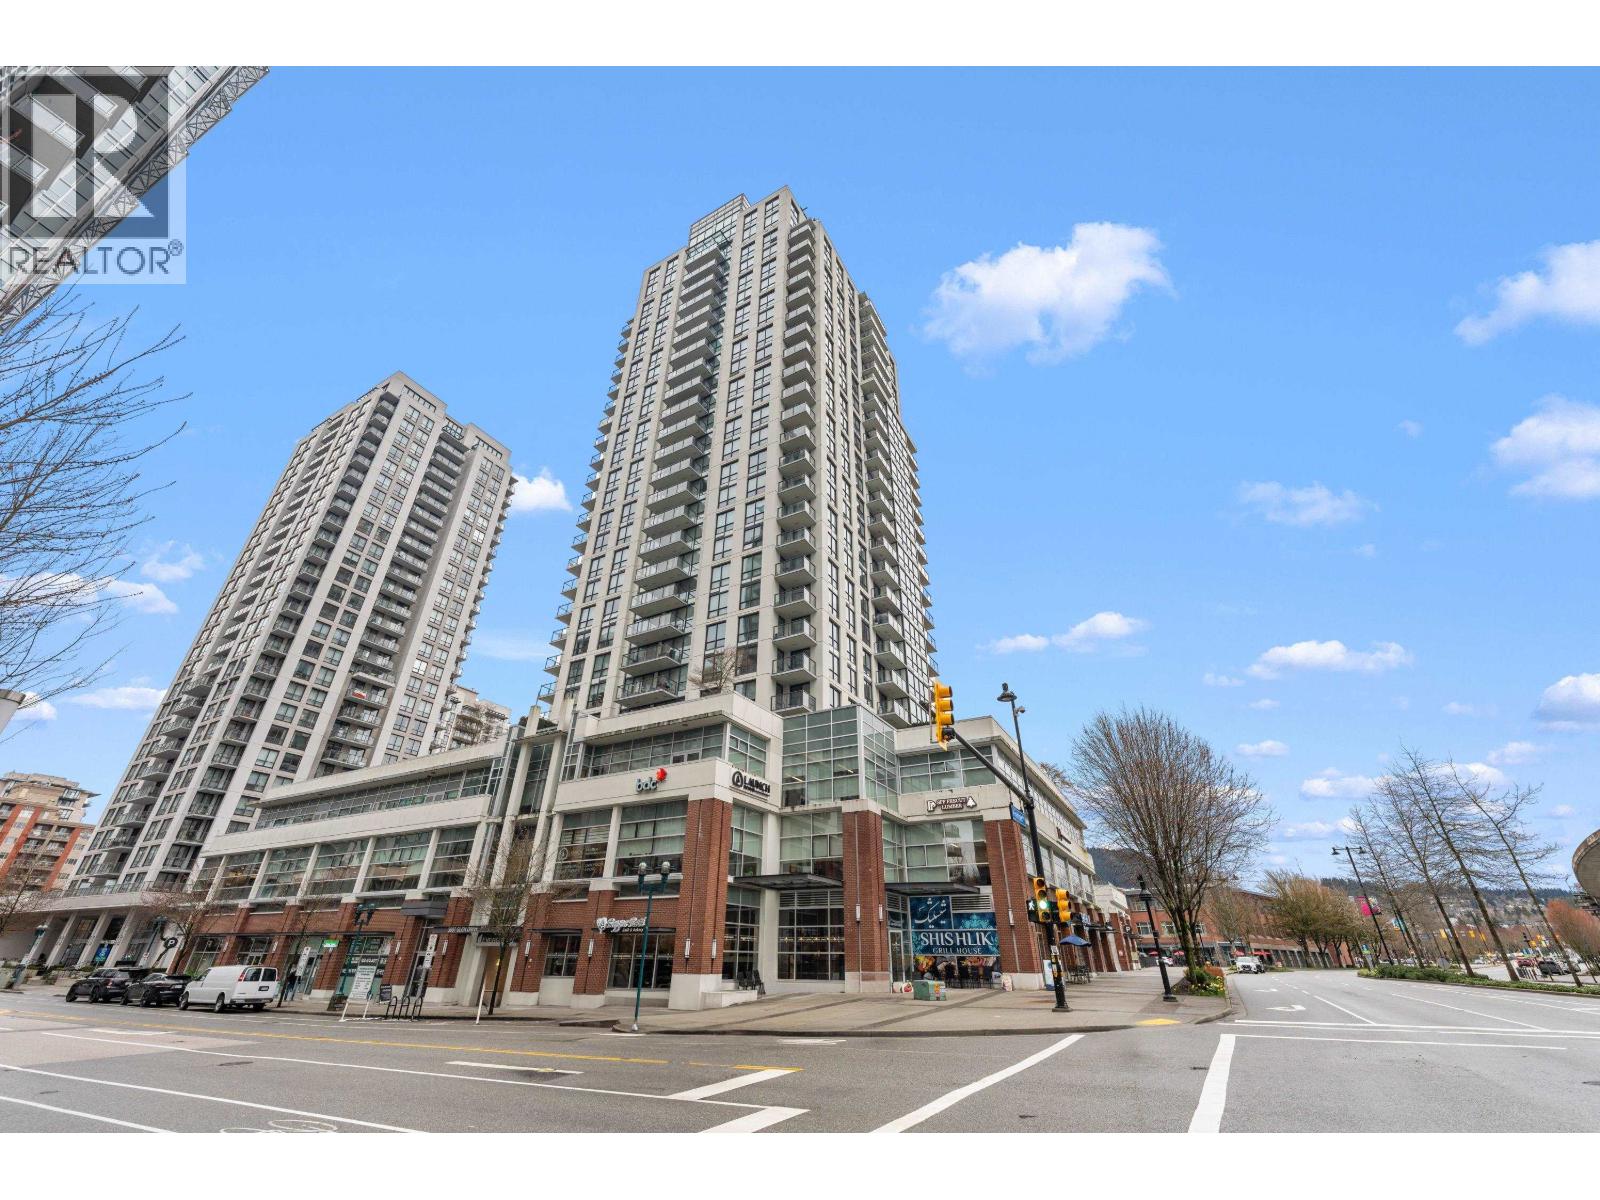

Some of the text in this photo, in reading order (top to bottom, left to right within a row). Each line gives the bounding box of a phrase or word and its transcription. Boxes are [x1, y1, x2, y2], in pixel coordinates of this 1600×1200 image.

[635, 777, 658, 793] bdc
[920, 931, 993, 946] SHISHLIK
[932, 947, 982, 955] GRILL HOUSE
